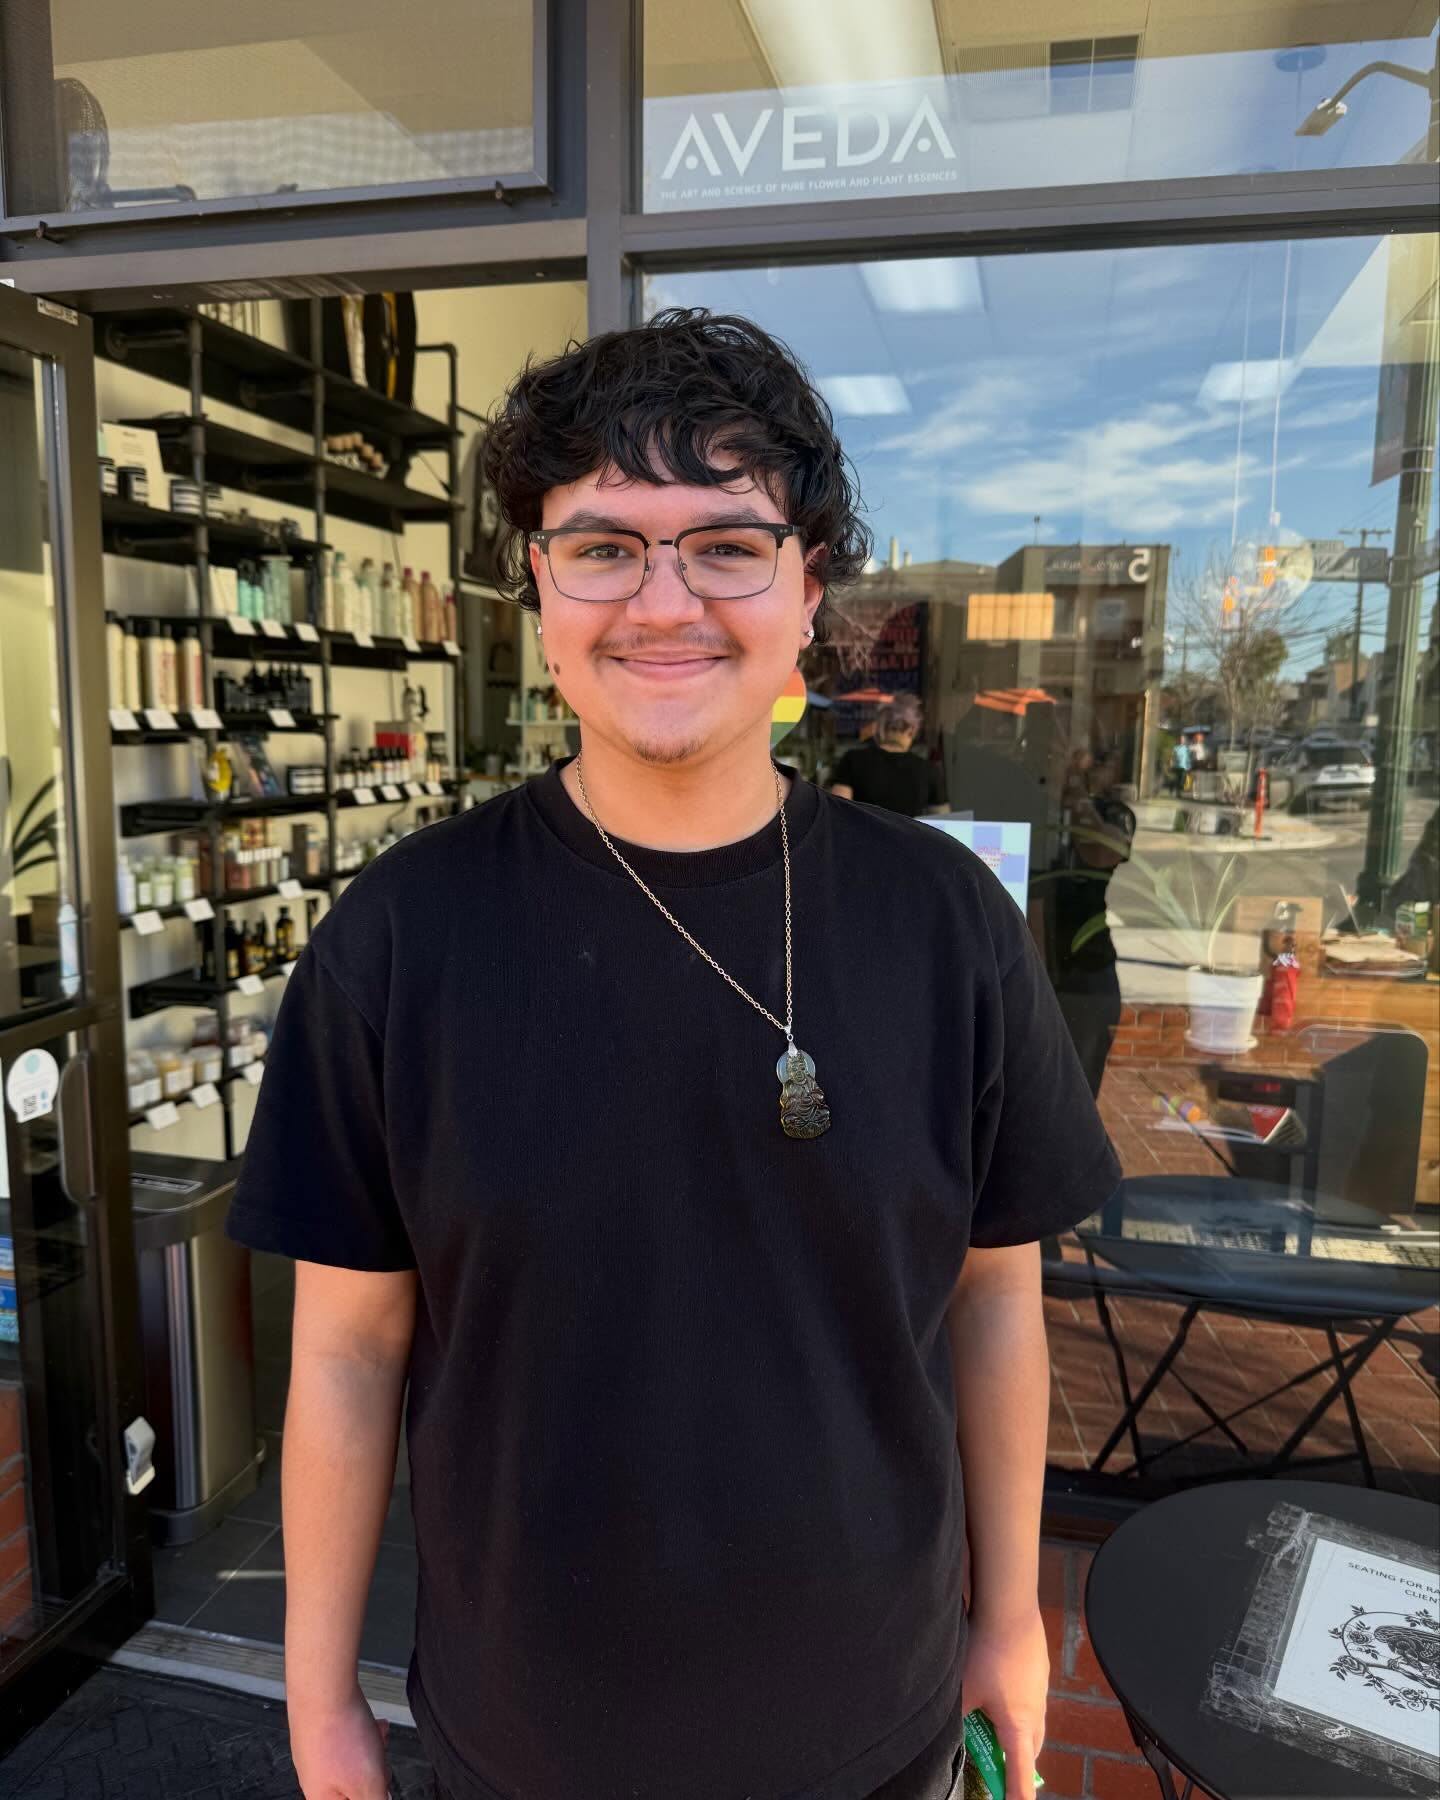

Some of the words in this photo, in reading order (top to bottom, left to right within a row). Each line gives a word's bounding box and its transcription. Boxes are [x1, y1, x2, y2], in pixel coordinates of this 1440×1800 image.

[660, 94, 957, 179] AVEDA
[660, 191, 679, 200] THE
[681, 188, 698, 199] ART
[702, 187, 721, 199] AND
[724, 183, 762, 196] SCIENCE
[765, 182, 777, 193] OF
[781, 181, 805, 193] PURE
[809, 178, 846, 190] FLOWER
[849, 176, 869, 188] AND
[872, 174, 904, 185] PLANT
[908, 169, 957, 184] ESSENCES
[1348, 1562, 1396, 1581] SEATING
[1400, 1577, 1423, 1589] FOR
[1404, 1589, 1440, 1603] CLIEN
